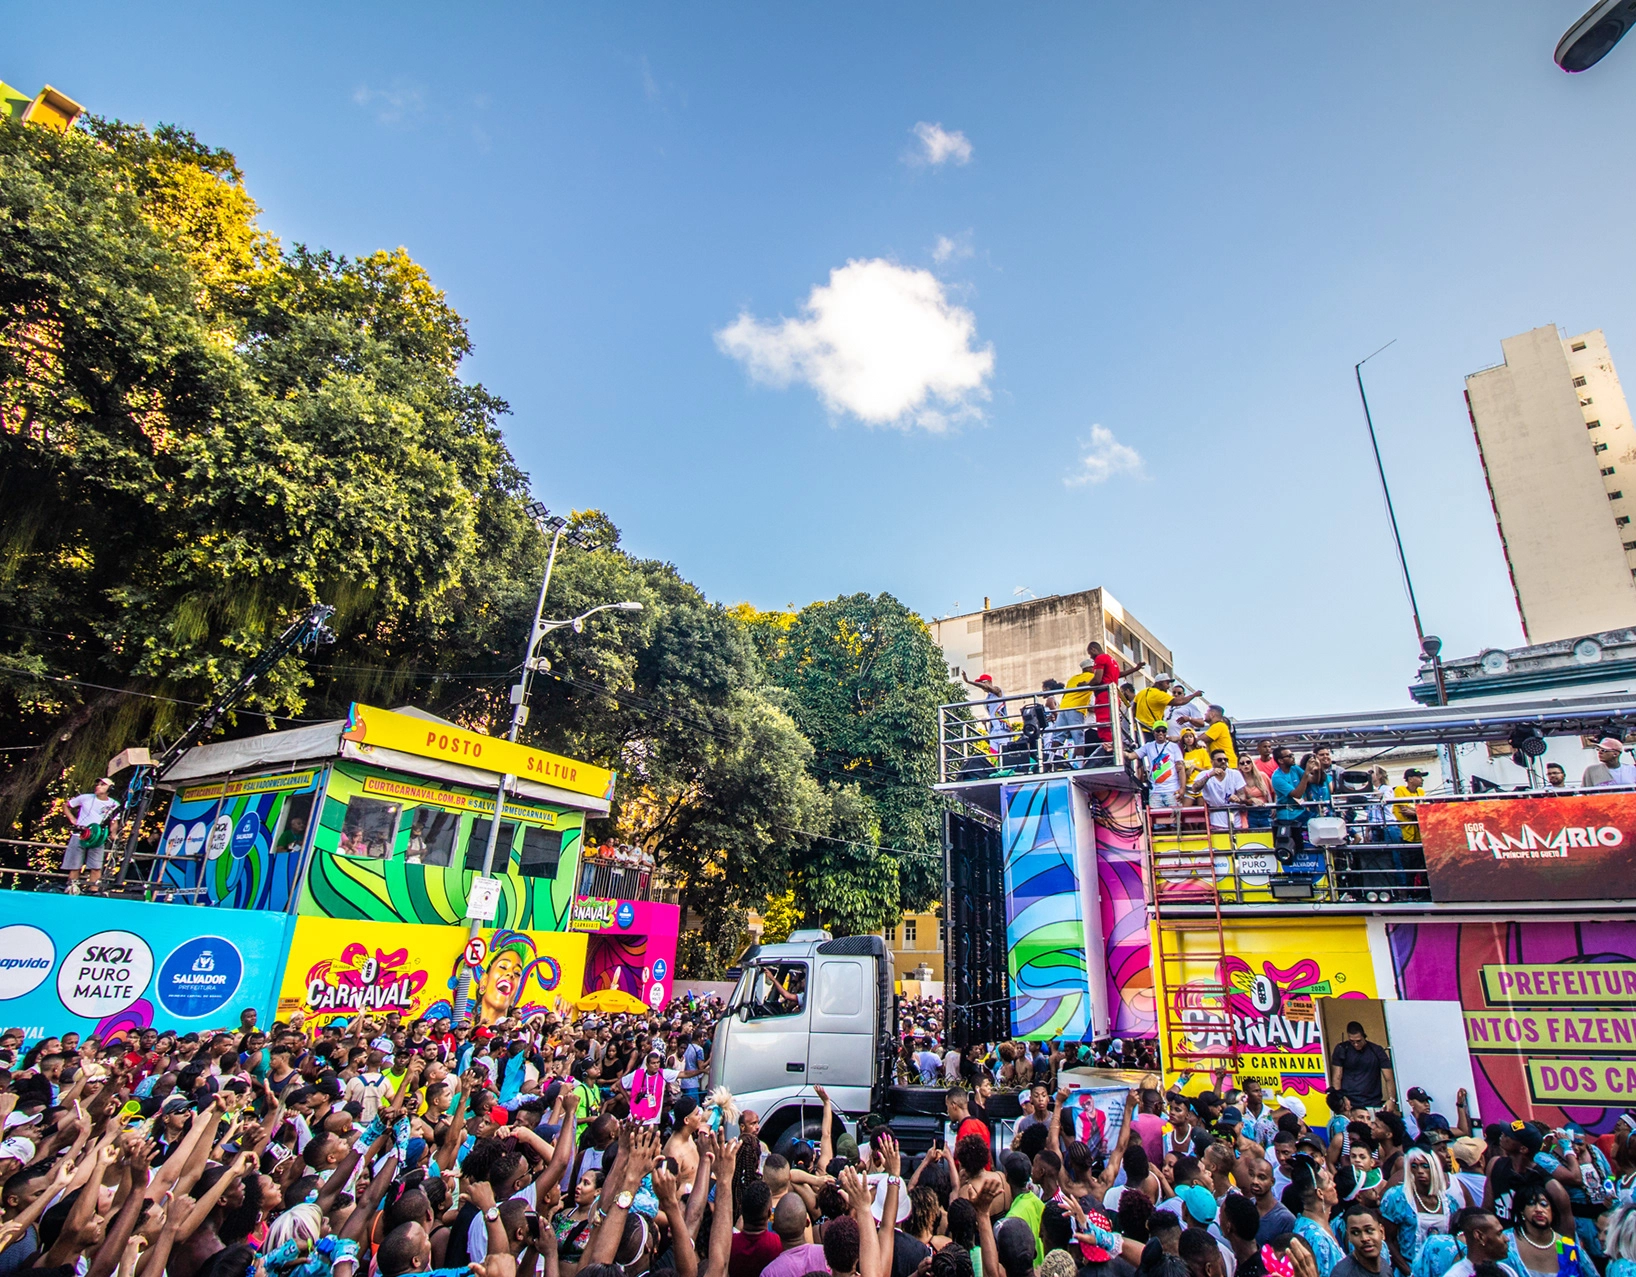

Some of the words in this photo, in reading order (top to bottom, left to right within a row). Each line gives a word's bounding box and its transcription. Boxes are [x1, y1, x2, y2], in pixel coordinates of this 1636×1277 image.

[517, 715, 525, 725] 3
[426, 731, 482, 758] POSTO
[527, 756, 578, 782] SALTUR
[368, 779, 467, 806] CURTACARNAVAL.COM.BR
[467, 799, 555, 822] @SALVAORMEUCARNAVAL
[1464, 822, 1485, 833] IGOR
[1530, 850, 1540, 859] DO
[1241, 860, 1267, 868] PURO
[82, 945, 134, 964] SKOL
[78, 967, 130, 981] PURO
[172, 973, 227, 985] SALVADOR
[73, 984, 134, 999] MALTE
[307, 978, 411, 1009] CARNAVAL
[1540, 1066, 1598, 1093] DOS
